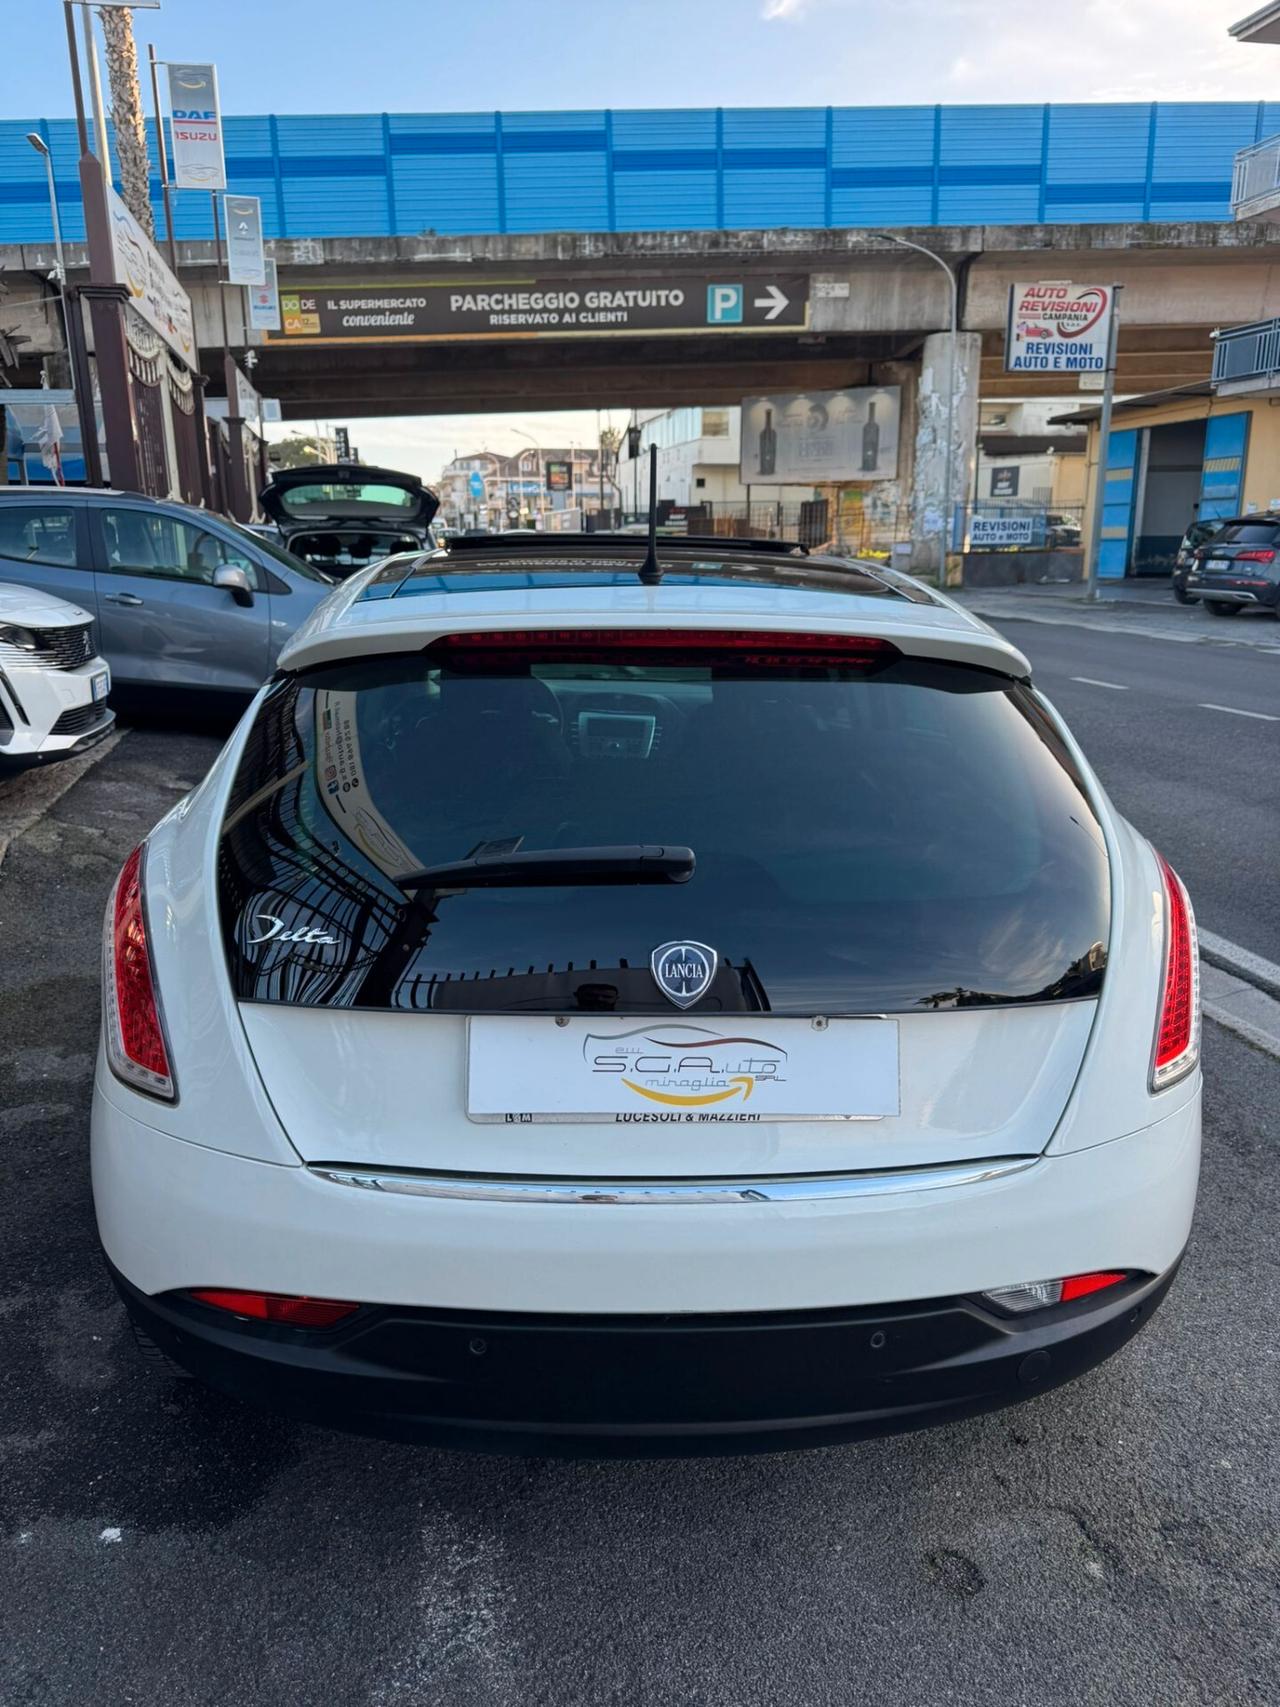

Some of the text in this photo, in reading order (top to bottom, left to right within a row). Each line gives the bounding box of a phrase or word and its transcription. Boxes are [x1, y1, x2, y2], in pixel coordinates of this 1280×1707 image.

[172, 110, 216, 119] DAF
[175, 131, 218, 141] ISUZU
[1024, 287, 1068, 299] AUTO
[327, 298, 427, 310] IL SUPERMERCATO
[450, 289, 685, 311] PARCHEGGIO GRATUITO
[714, 288, 738, 320] P
[1019, 300, 1098, 312] REVISIONI
[342, 311, 415, 326] conveniente
[489, 311, 628, 325] RISERVATO AI CLIENTI
[1042, 313, 1088, 321] CAMPANIA
[1026, 342, 1093, 355] REVISIONI
[1014, 356, 1104, 369] AUTO E MOTO
[973, 521, 1031, 532] REVISIONI
[973, 533, 997, 541] AUTO
[247, 914, 341, 944] Delta
[665, 963, 704, 978] LANCIA
[645, 1077, 730, 1091] miraglia
[615, 1113, 682, 1122] LUCESOLI
[685, 1113, 694, 1121] &
